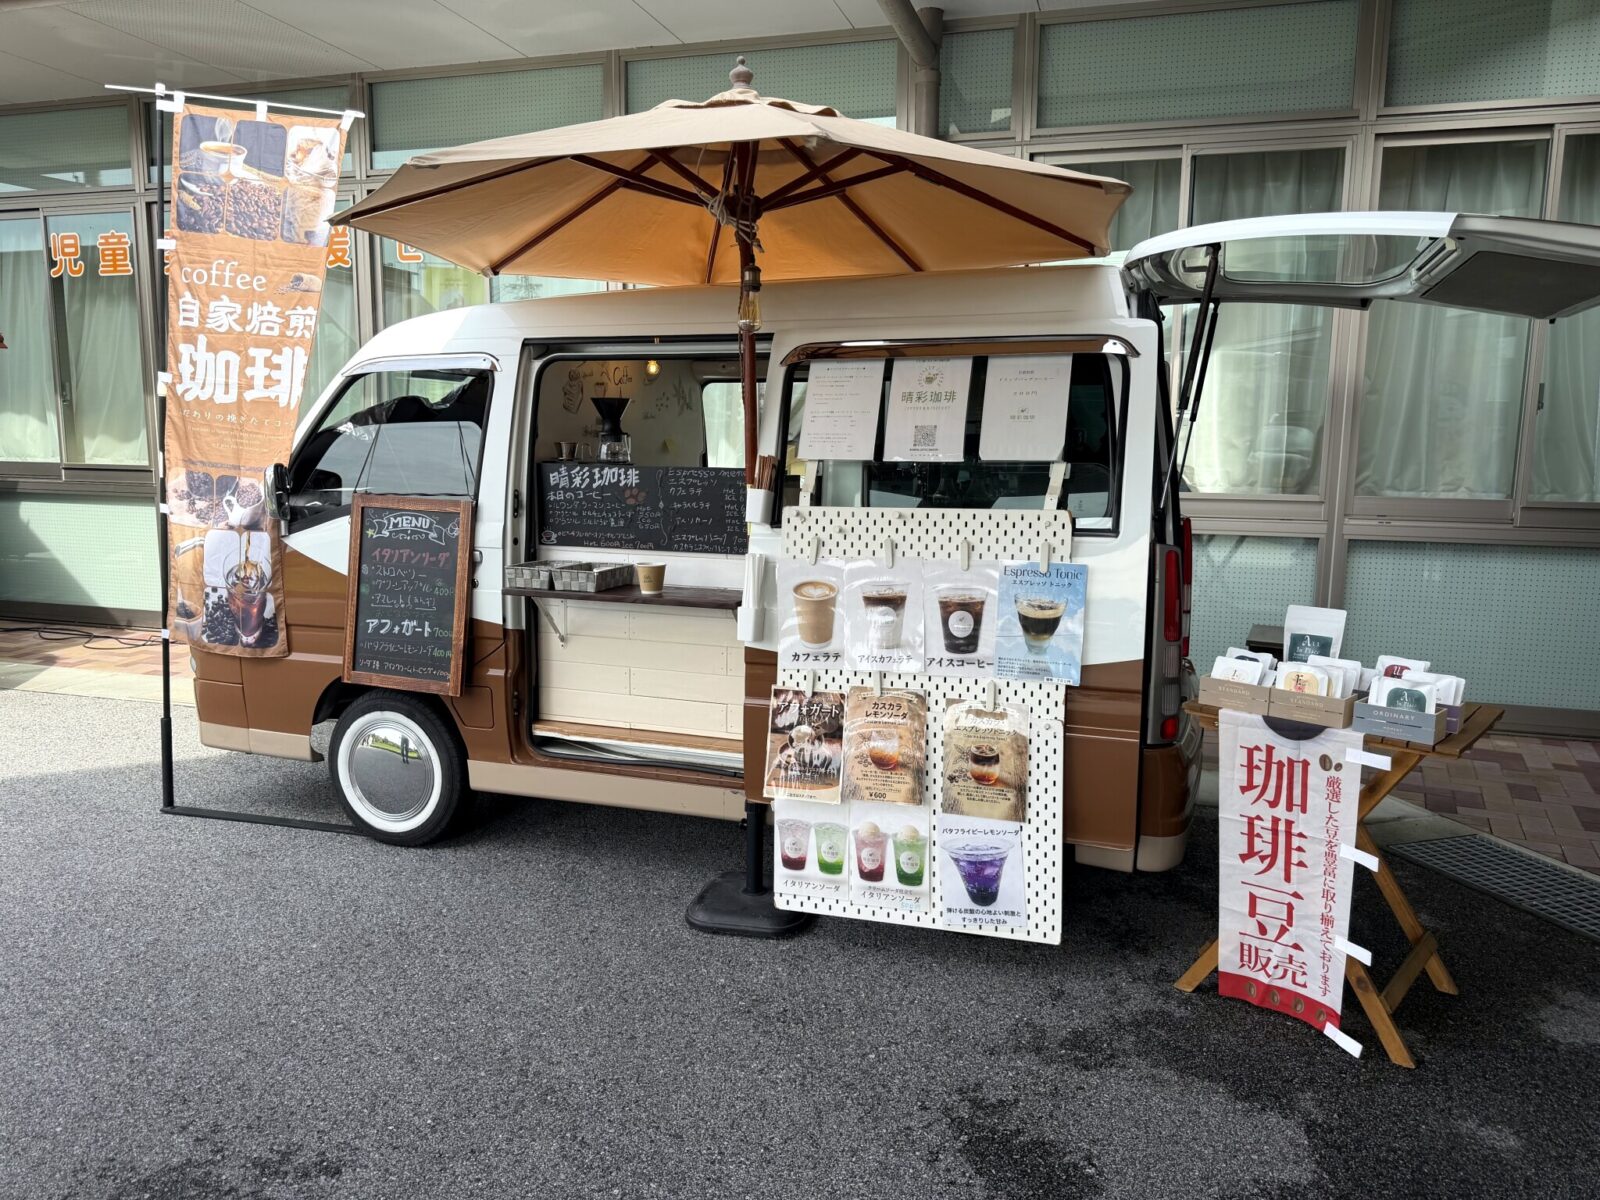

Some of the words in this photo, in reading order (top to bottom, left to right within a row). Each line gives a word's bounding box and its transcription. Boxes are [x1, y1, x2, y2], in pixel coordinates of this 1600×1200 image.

[50, 230, 134, 278] 児童
[181, 260, 267, 292] coffee
[177, 290, 317, 338] 自家焙煎
[176, 334, 308, 411] 珈琲
[901, 390, 957, 403] 晴彩珈琲
[549, 464, 640, 489] 晴彩珈琲
[668, 468, 716, 478] Espresso
[546, 490, 612, 501] 本日のコーヒー
[389, 515, 430, 529] MENU
[371, 547, 451, 568] イタリアンソーダ
[1003, 565, 1051, 580] Espresso
[1054, 568, 1083, 581] Tonic
[1011, 579, 1047, 588] エスプレッソ
[1050, 580, 1073, 588] トニック
[366, 618, 432, 637] アフォガート
[791, 652, 842, 663] カフェラテ
[857, 654, 913, 664] アイスカフェラテ
[926, 657, 995, 669] アイスコーヒー
[1218, 686, 1251, 696] STANDARD
[777, 702, 840, 717] アフォガート
[871, 701, 903, 711] カスカラ
[1290, 698, 1324, 708] STANDARD
[865, 710, 908, 720] レモンソーダ
[1372, 710, 1415, 721] ORDINARY
[869, 791, 887, 799] ¥600
[1238, 743, 1311, 952] 珈琲豆
[783, 879, 841, 892] イタリアンソーダ
[1319, 775, 1342, 997] 厳選した豆を豊富に取り揃えております
[862, 891, 921, 904] イタリアンソーダ
[961, 917, 1008, 925] すっきりした甘み
[1238, 941, 1308, 989] 販売
